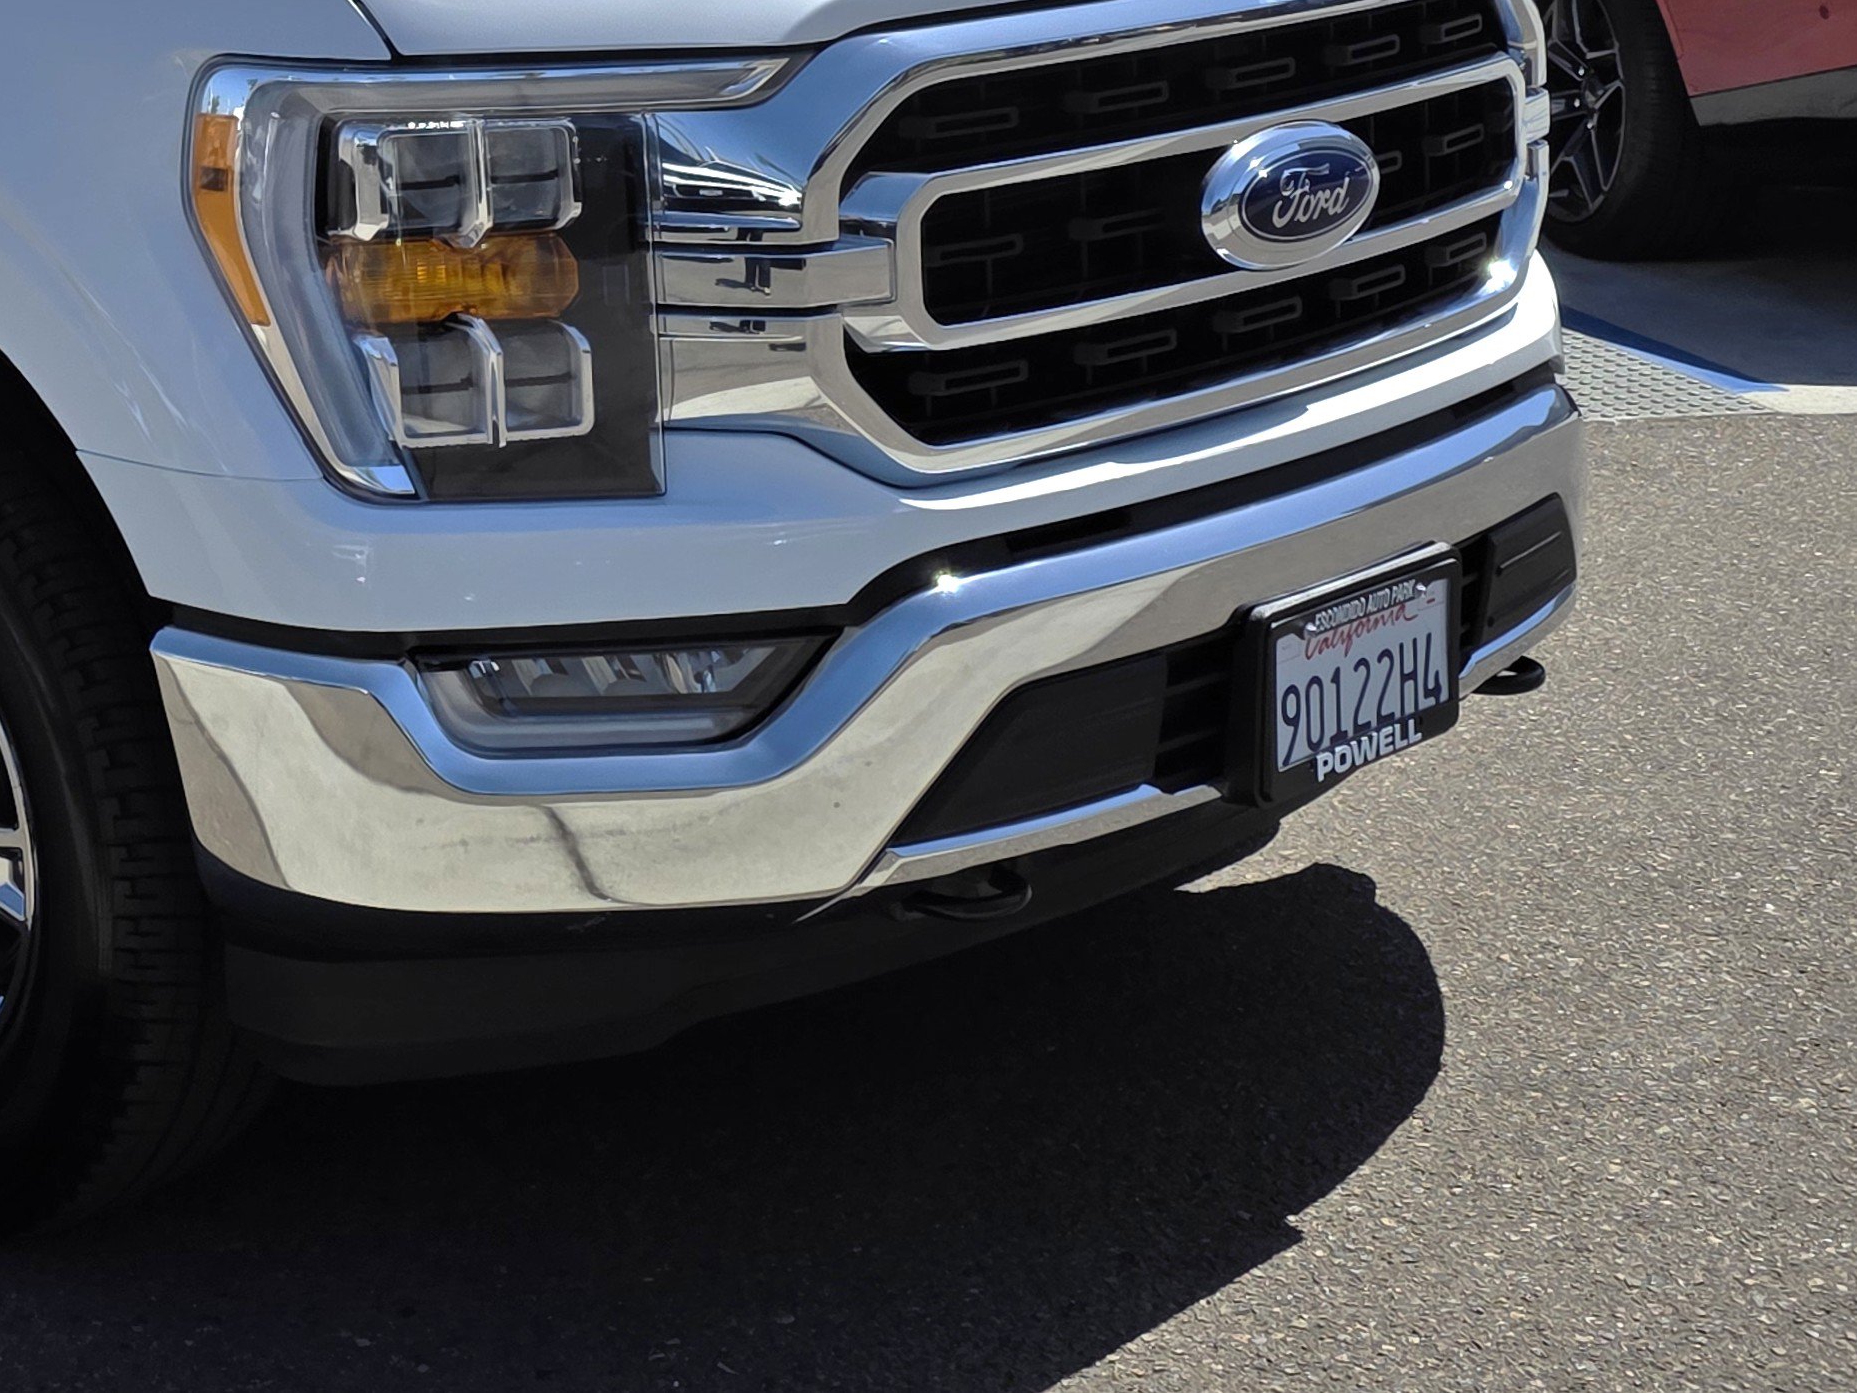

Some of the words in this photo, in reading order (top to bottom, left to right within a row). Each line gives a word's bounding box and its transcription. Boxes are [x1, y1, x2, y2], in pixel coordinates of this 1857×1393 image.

[1271, 163, 1351, 228] Ford
[1305, 603, 1419, 660] California
[1280, 632, 1443, 768] 90122H4
[1315, 718, 1423, 783] POWELL
